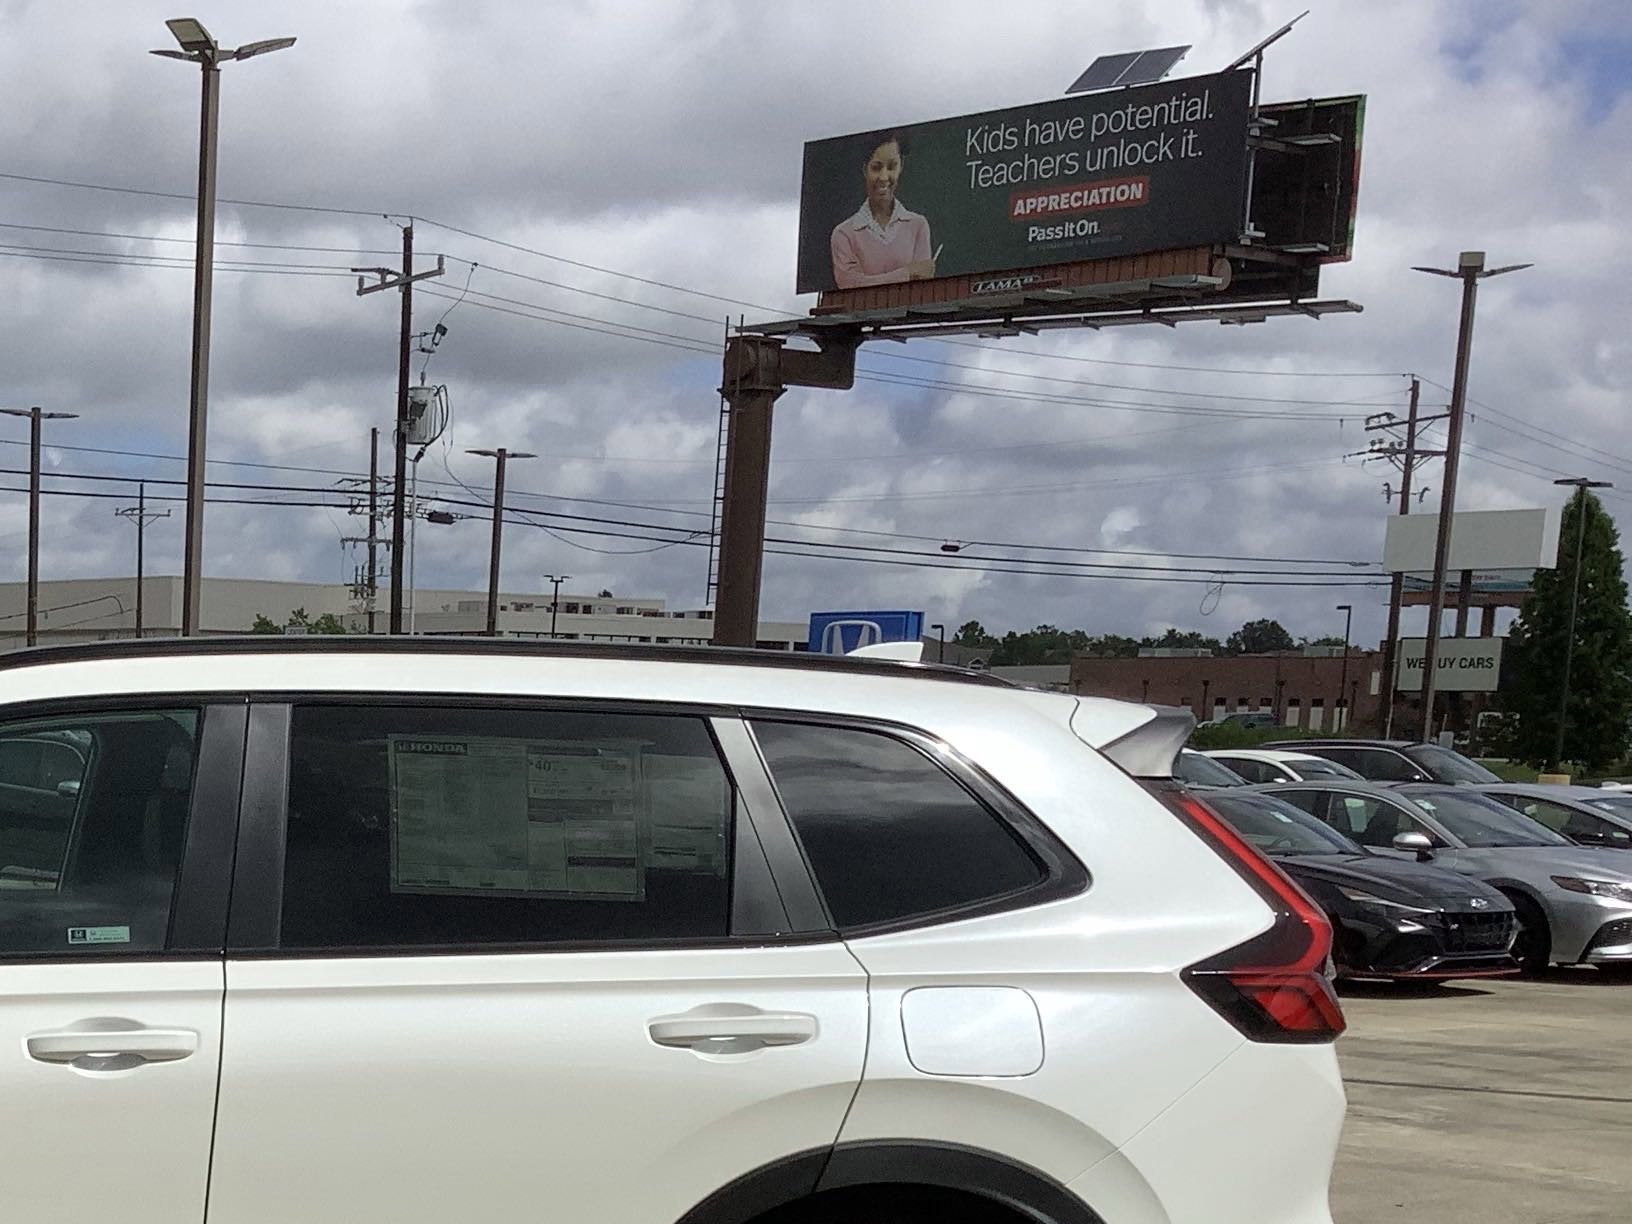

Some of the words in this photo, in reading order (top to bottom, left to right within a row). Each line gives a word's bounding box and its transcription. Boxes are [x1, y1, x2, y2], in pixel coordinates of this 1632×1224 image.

[965, 123, 1018, 156] Kids
[1024, 118, 1085, 147] have
[1090, 89, 1215, 143] potential.
[966, 151, 1080, 189] Teachers
[1086, 132, 1175, 172] unlock
[1180, 129, 1204, 158] it.
[1013, 182, 1144, 216] APPRECIATION
[1406, 657, 1426, 669] WE
[1459, 657, 1494, 669] CARS
